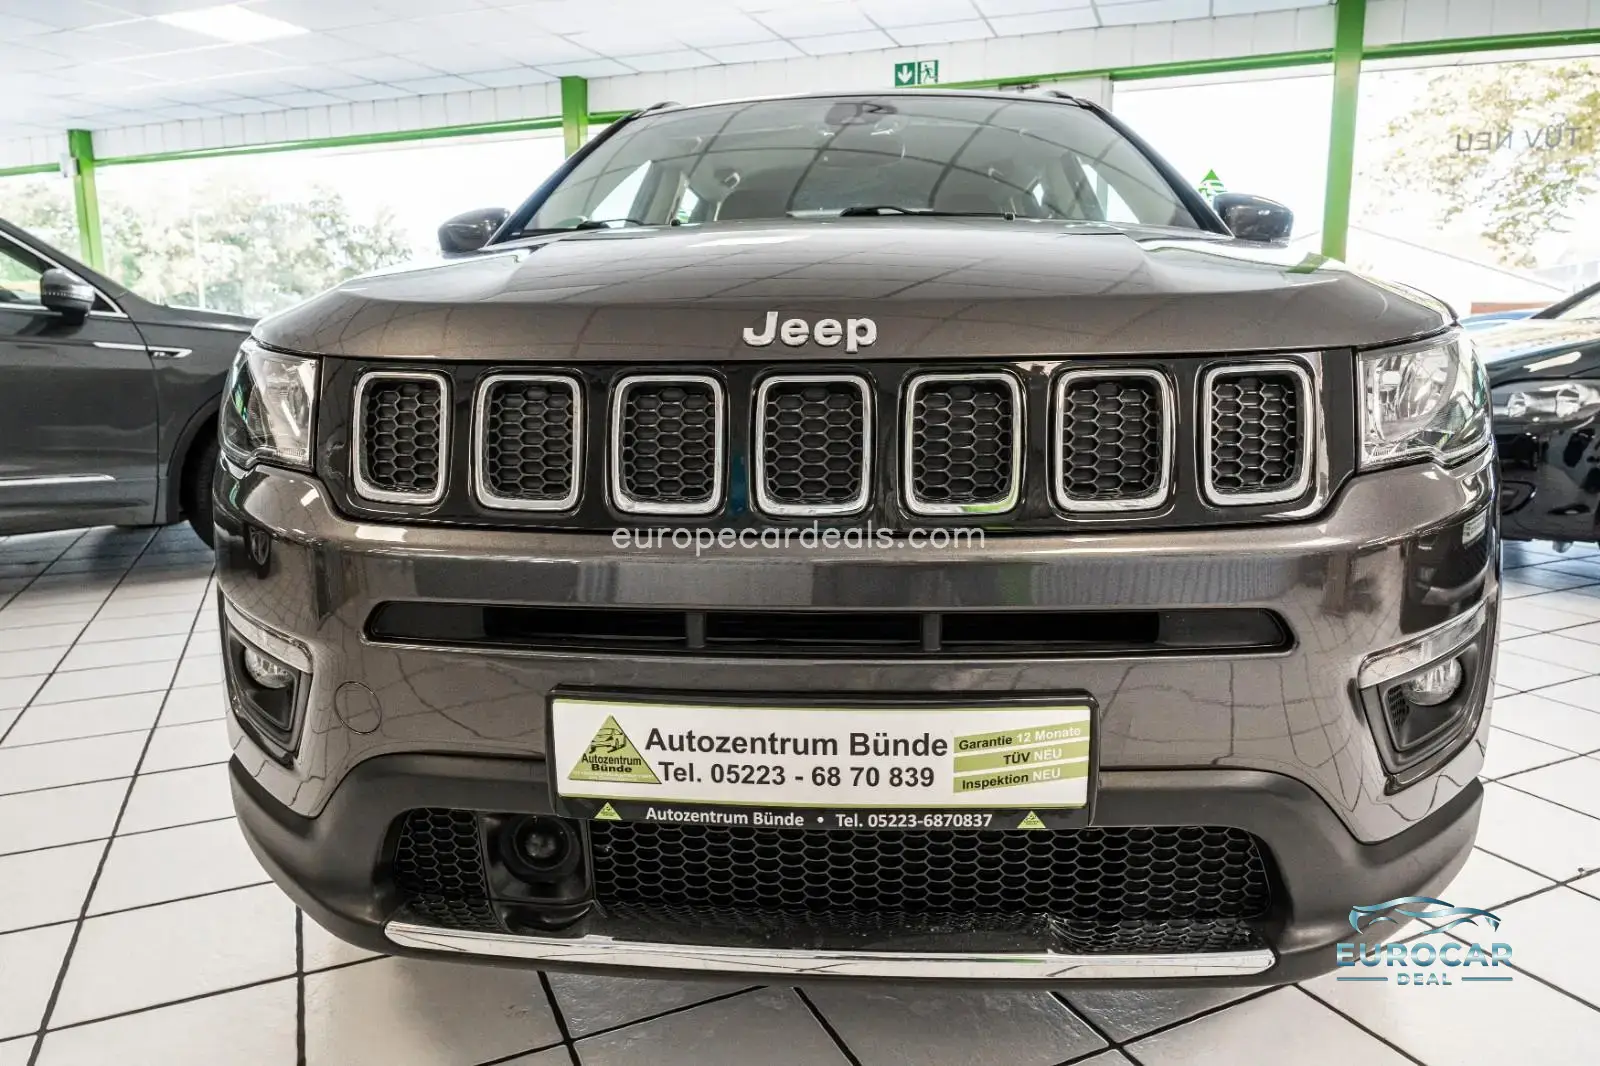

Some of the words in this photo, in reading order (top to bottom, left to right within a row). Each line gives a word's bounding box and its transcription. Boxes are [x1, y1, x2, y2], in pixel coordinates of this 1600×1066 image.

[743, 311, 877, 353] Jeep
[645, 728, 838, 756] Autozentrum
[850, 732, 948, 757] Bünde
[958, 736, 1013, 751] Garantie
[1016, 732, 1031, 743] 12
[1034, 727, 1081, 741] Monate
[581, 753, 642, 766] Autozentrum
[591, 763, 633, 773] Bünde
[1003, 752, 1031, 765] TÜV
[1034, 748, 1062, 761] NEU
[658, 761, 702, 783] Tel.
[710, 763, 786, 785] 05223
[811, 766, 841, 787] 68
[850, 767, 880, 787] 70
[889, 767, 935, 787] 839
[962, 774, 1029, 790] Inspektion
[1032, 767, 1061, 781] NEU
[645, 807, 749, 825] Autozentrum
[753, 812, 805, 826] Bünde
[836, 813, 864, 827] Tel.
[867, 813, 993, 828] 05223-6870837
